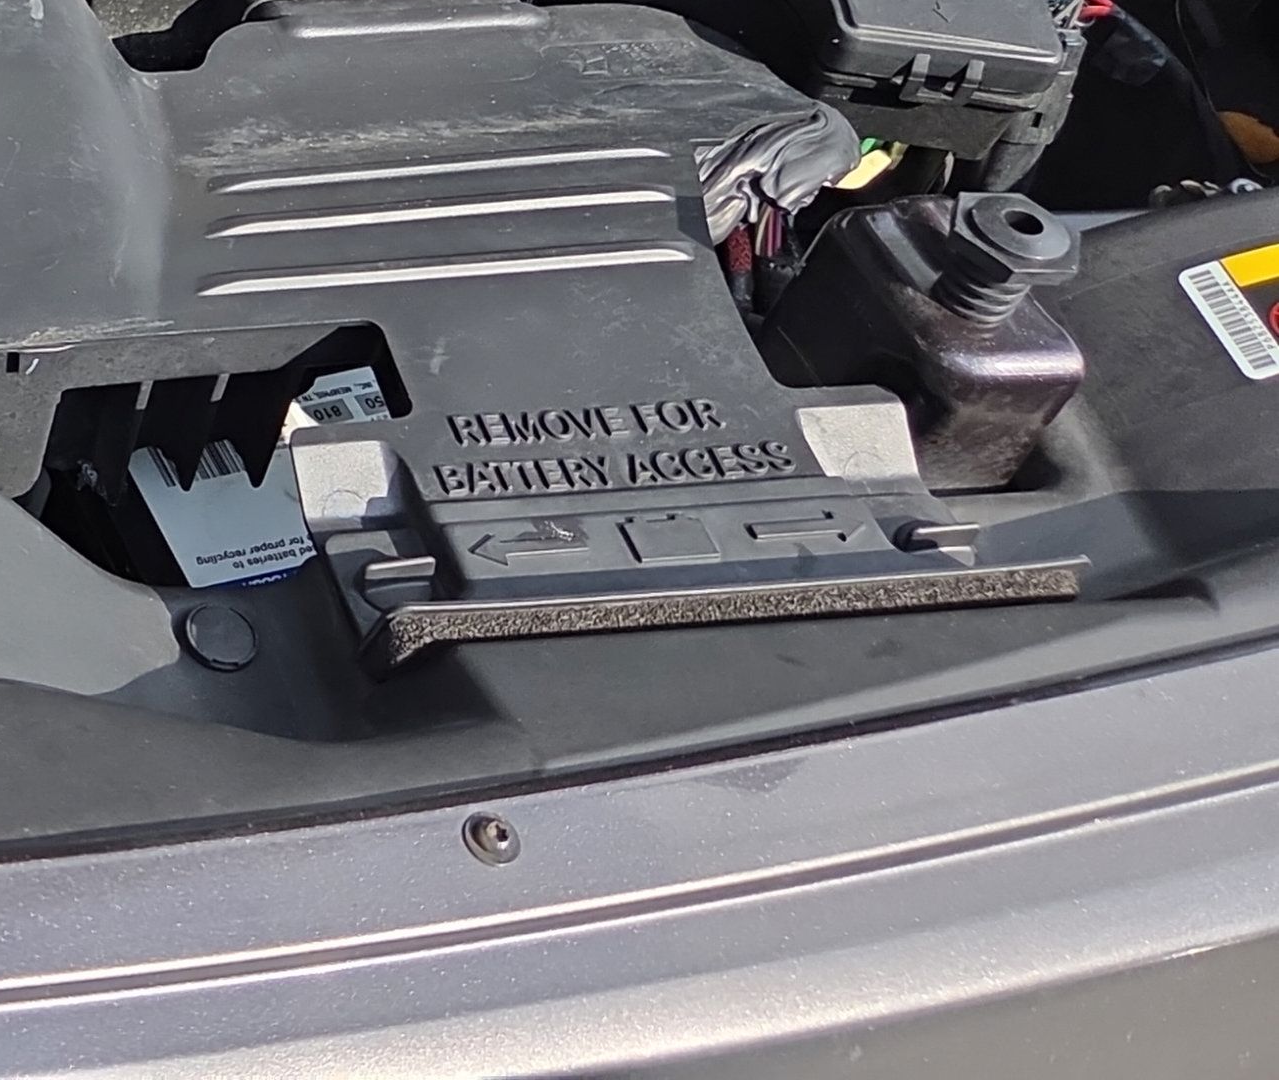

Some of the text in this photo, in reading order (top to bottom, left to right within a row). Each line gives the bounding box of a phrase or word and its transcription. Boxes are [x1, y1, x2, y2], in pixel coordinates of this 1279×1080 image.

[313, 405, 342, 421] 810
[446, 398, 726, 447] REMOVE FOR
[432, 439, 799, 497] BATTERY ACCESS
[195, 535, 305, 565] for proper recycling
[246, 548, 297, 566] batteries
[232, 559, 245, 569] to
